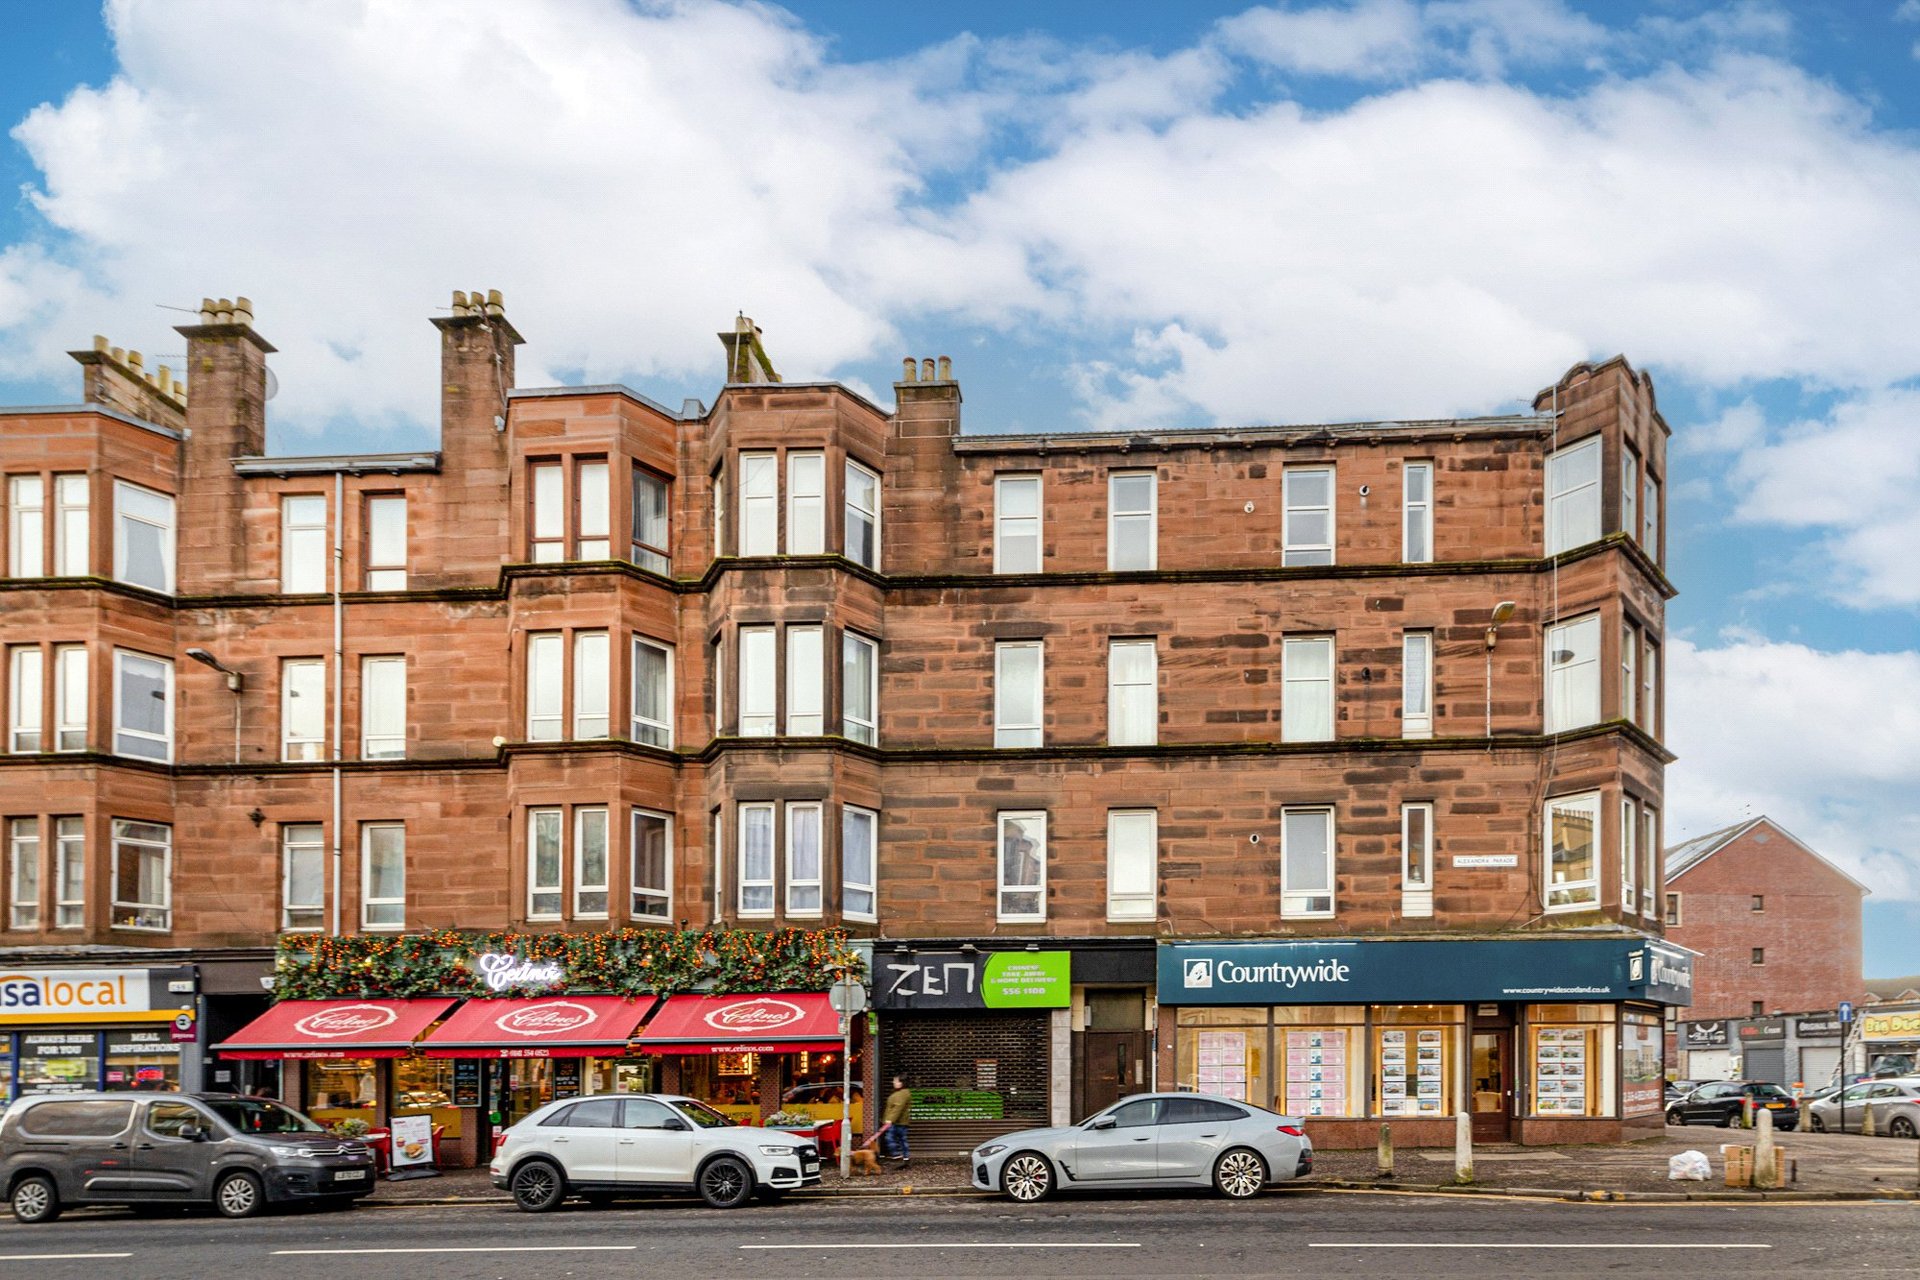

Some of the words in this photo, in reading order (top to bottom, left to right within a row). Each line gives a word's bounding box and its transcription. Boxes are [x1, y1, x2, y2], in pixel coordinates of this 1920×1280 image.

[1217, 958, 1350, 989] Countrywide
[25, 1035, 66, 1043] ALWAYS
[67, 1034, 94, 1043] HERE
[131, 1033, 160, 1041] MEAL
[37, 1046, 59, 1054] FOR
[60, 1045, 82, 1054] YOU
[110, 1044, 181, 1053] INSPIRATIONS
